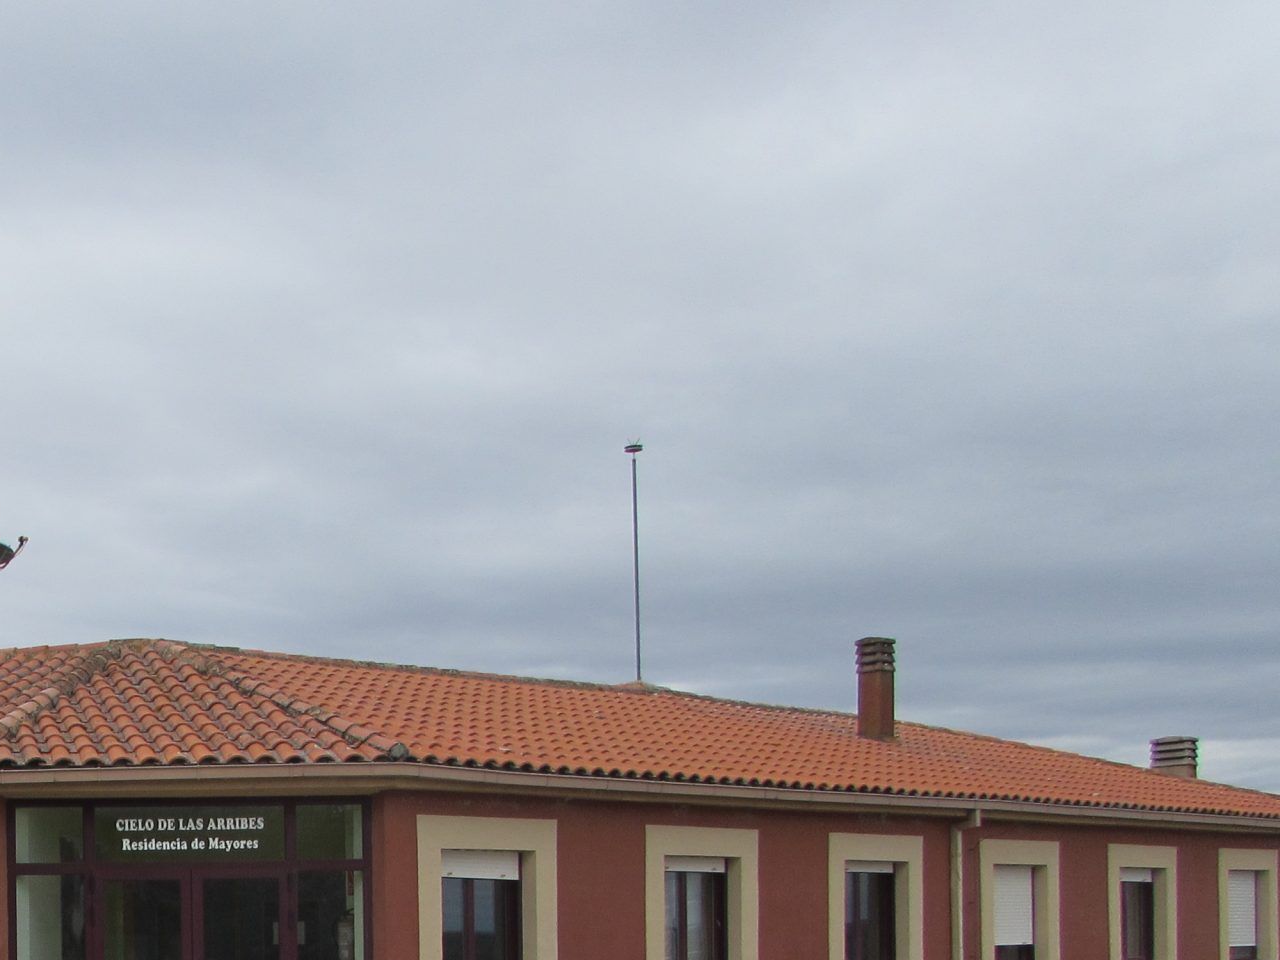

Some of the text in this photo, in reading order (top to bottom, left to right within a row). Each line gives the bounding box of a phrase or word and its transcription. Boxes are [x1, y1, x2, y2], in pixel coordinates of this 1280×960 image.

[116, 817, 265, 831] CIELO DE LAS ARRIBES
[122, 837, 259, 852] Residencia de Mayores
